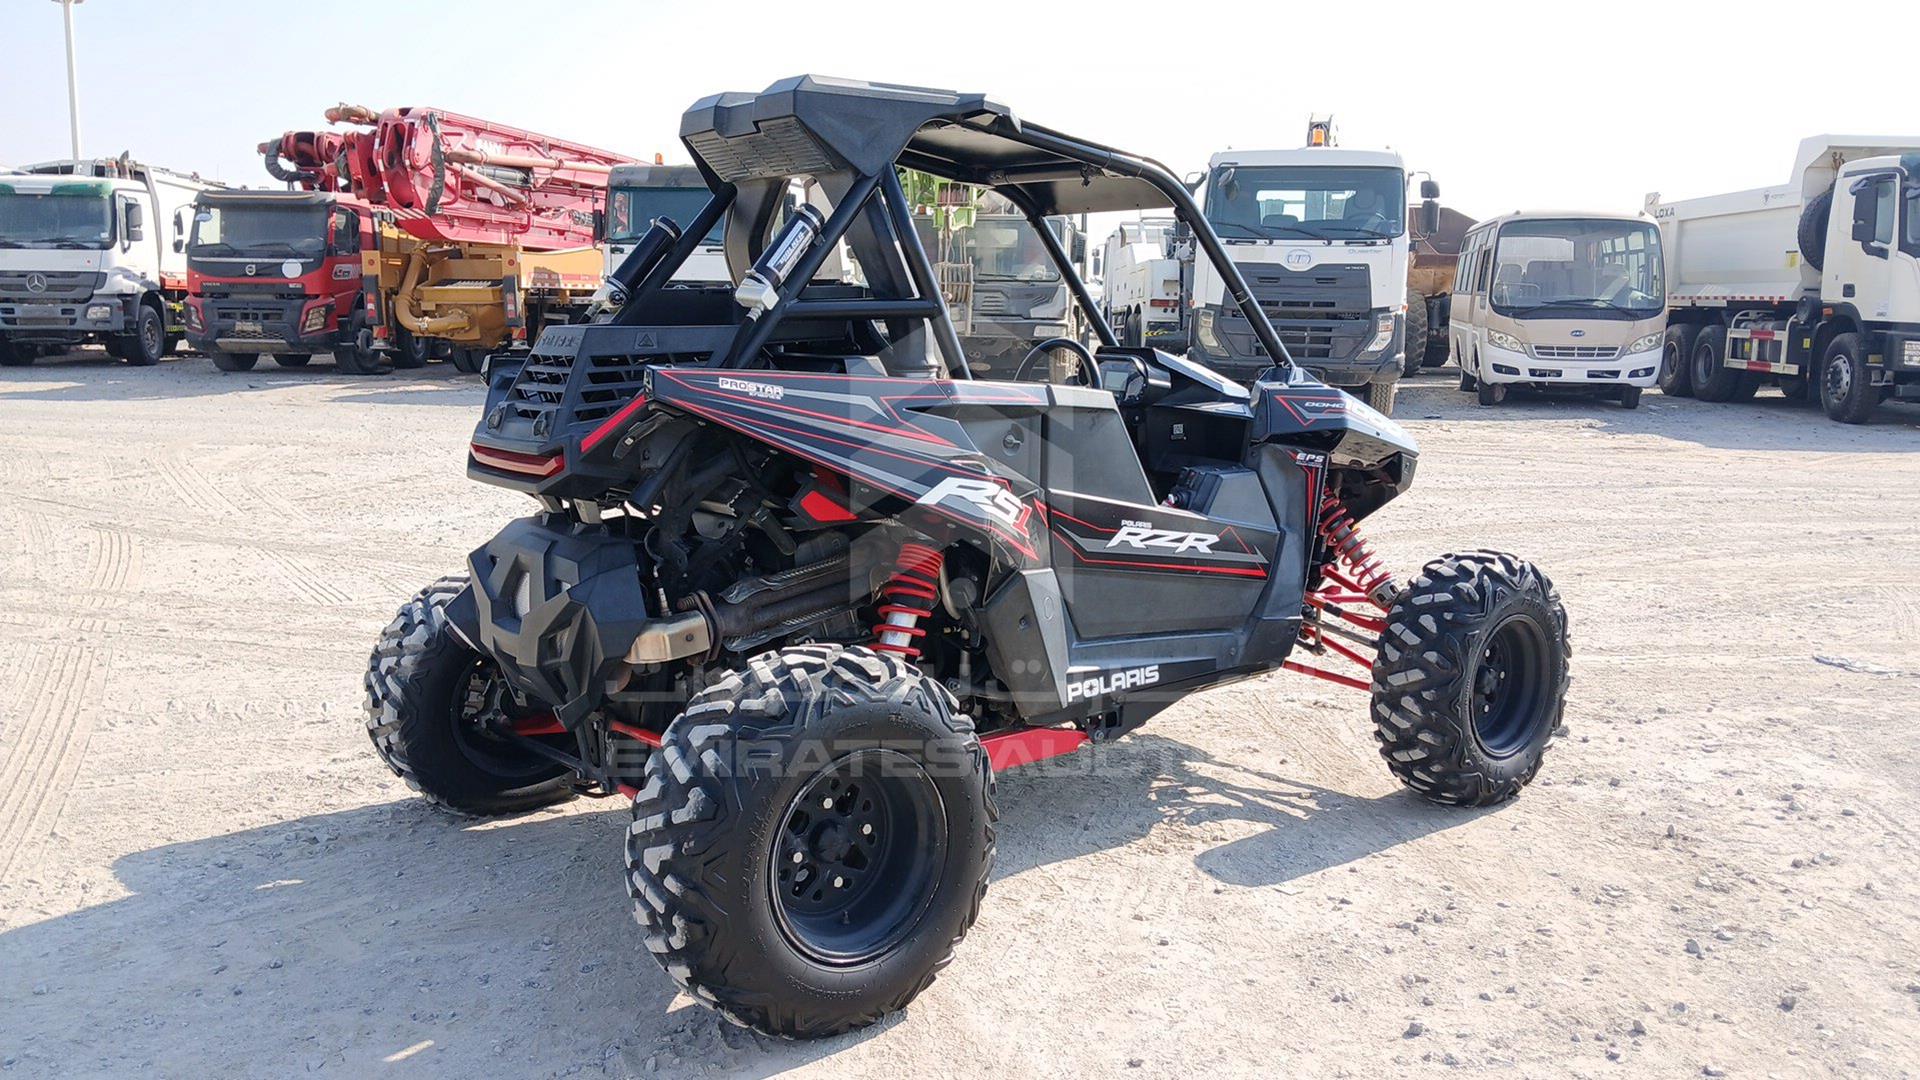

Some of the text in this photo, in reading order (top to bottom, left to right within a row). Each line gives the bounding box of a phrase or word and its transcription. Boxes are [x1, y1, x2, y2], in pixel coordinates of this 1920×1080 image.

[1654, 206, 1675, 219] LOXA
[720, 379, 783, 396] PROSTAR
[1305, 401, 1344, 409] DOHC
[1296, 452, 1325, 463] EPS
[916, 476, 1032, 540] RS1
[1121, 519, 1152, 529] POLARIS
[1104, 526, 1220, 554] RZR
[1067, 665, 1160, 702] POLARIS
